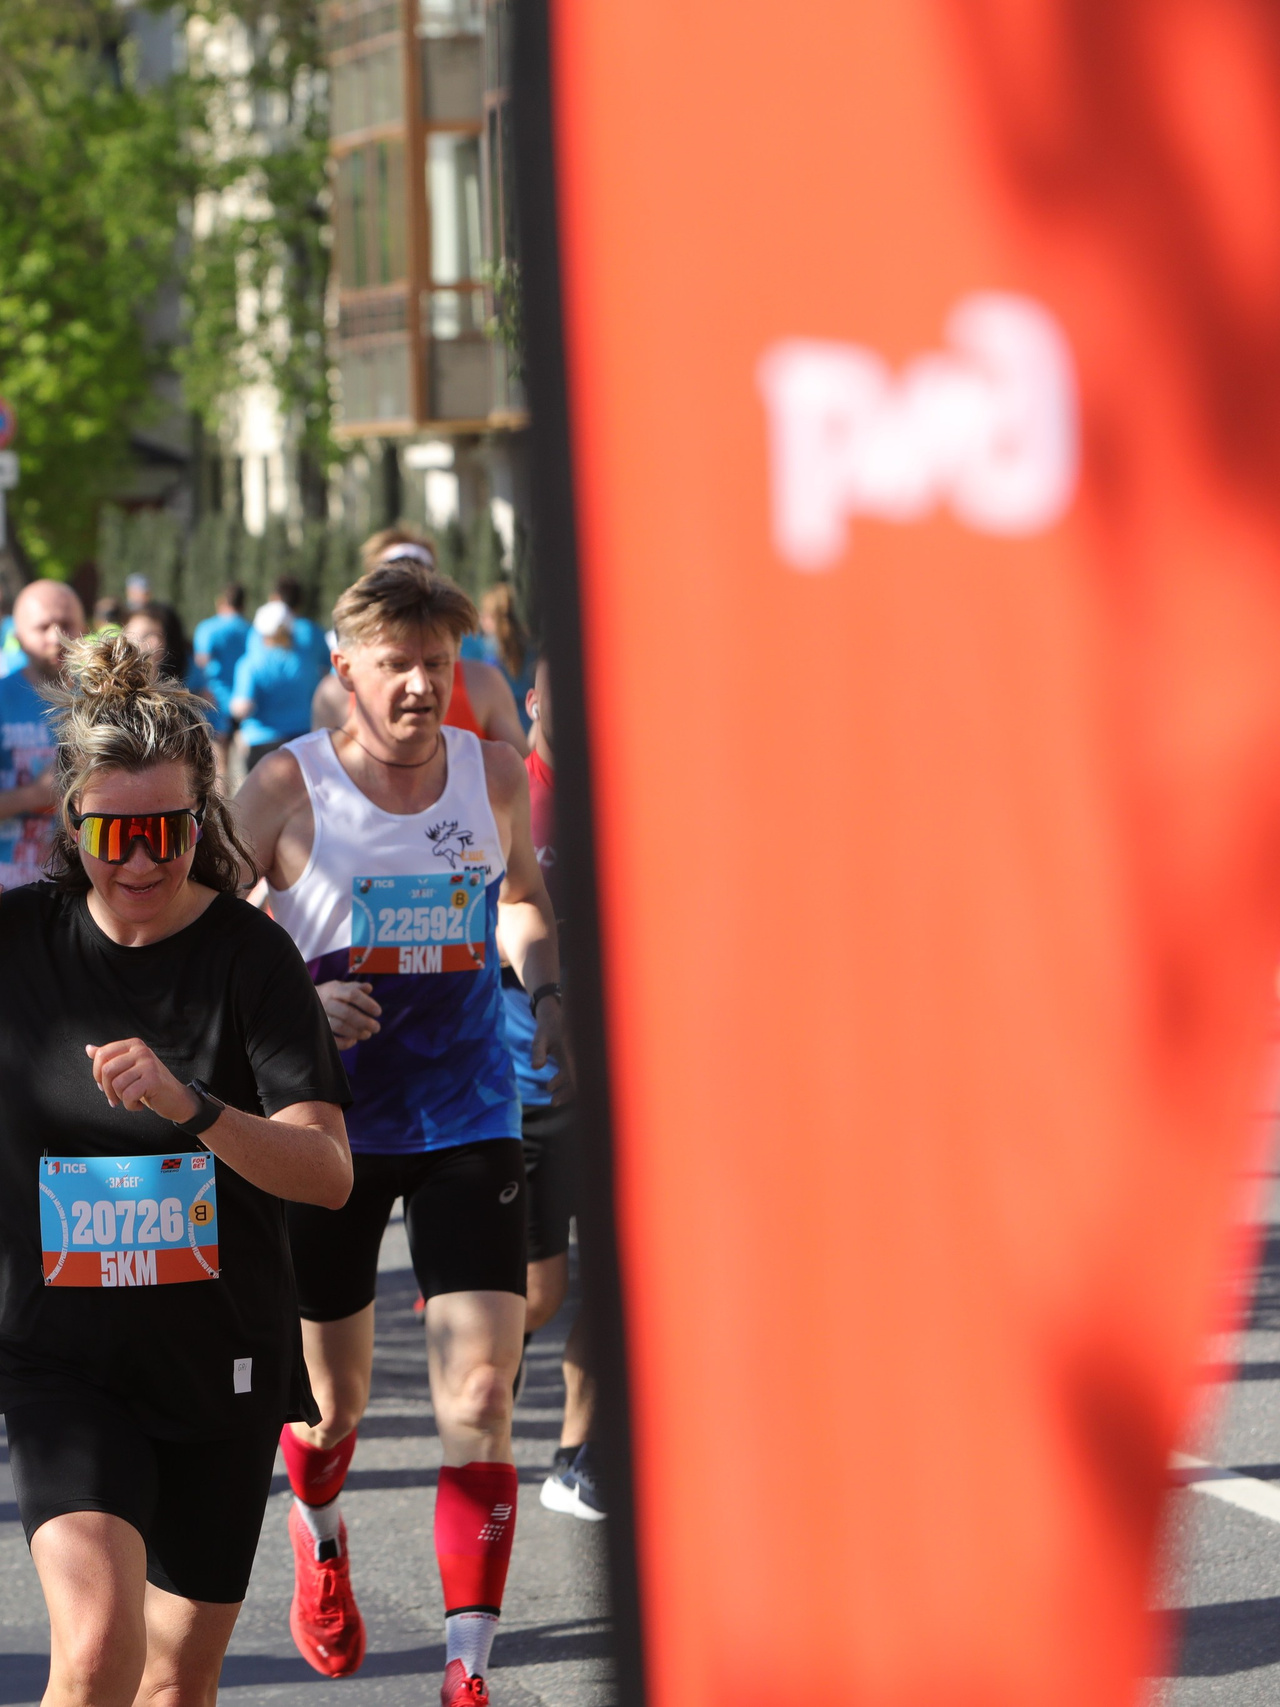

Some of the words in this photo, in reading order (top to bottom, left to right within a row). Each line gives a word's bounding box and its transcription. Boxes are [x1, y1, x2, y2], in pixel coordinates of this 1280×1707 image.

[377, 905, 464, 942] 22592
[62, 1163, 87, 1175] ПСБ
[71, 1197, 185, 1245] 20726
